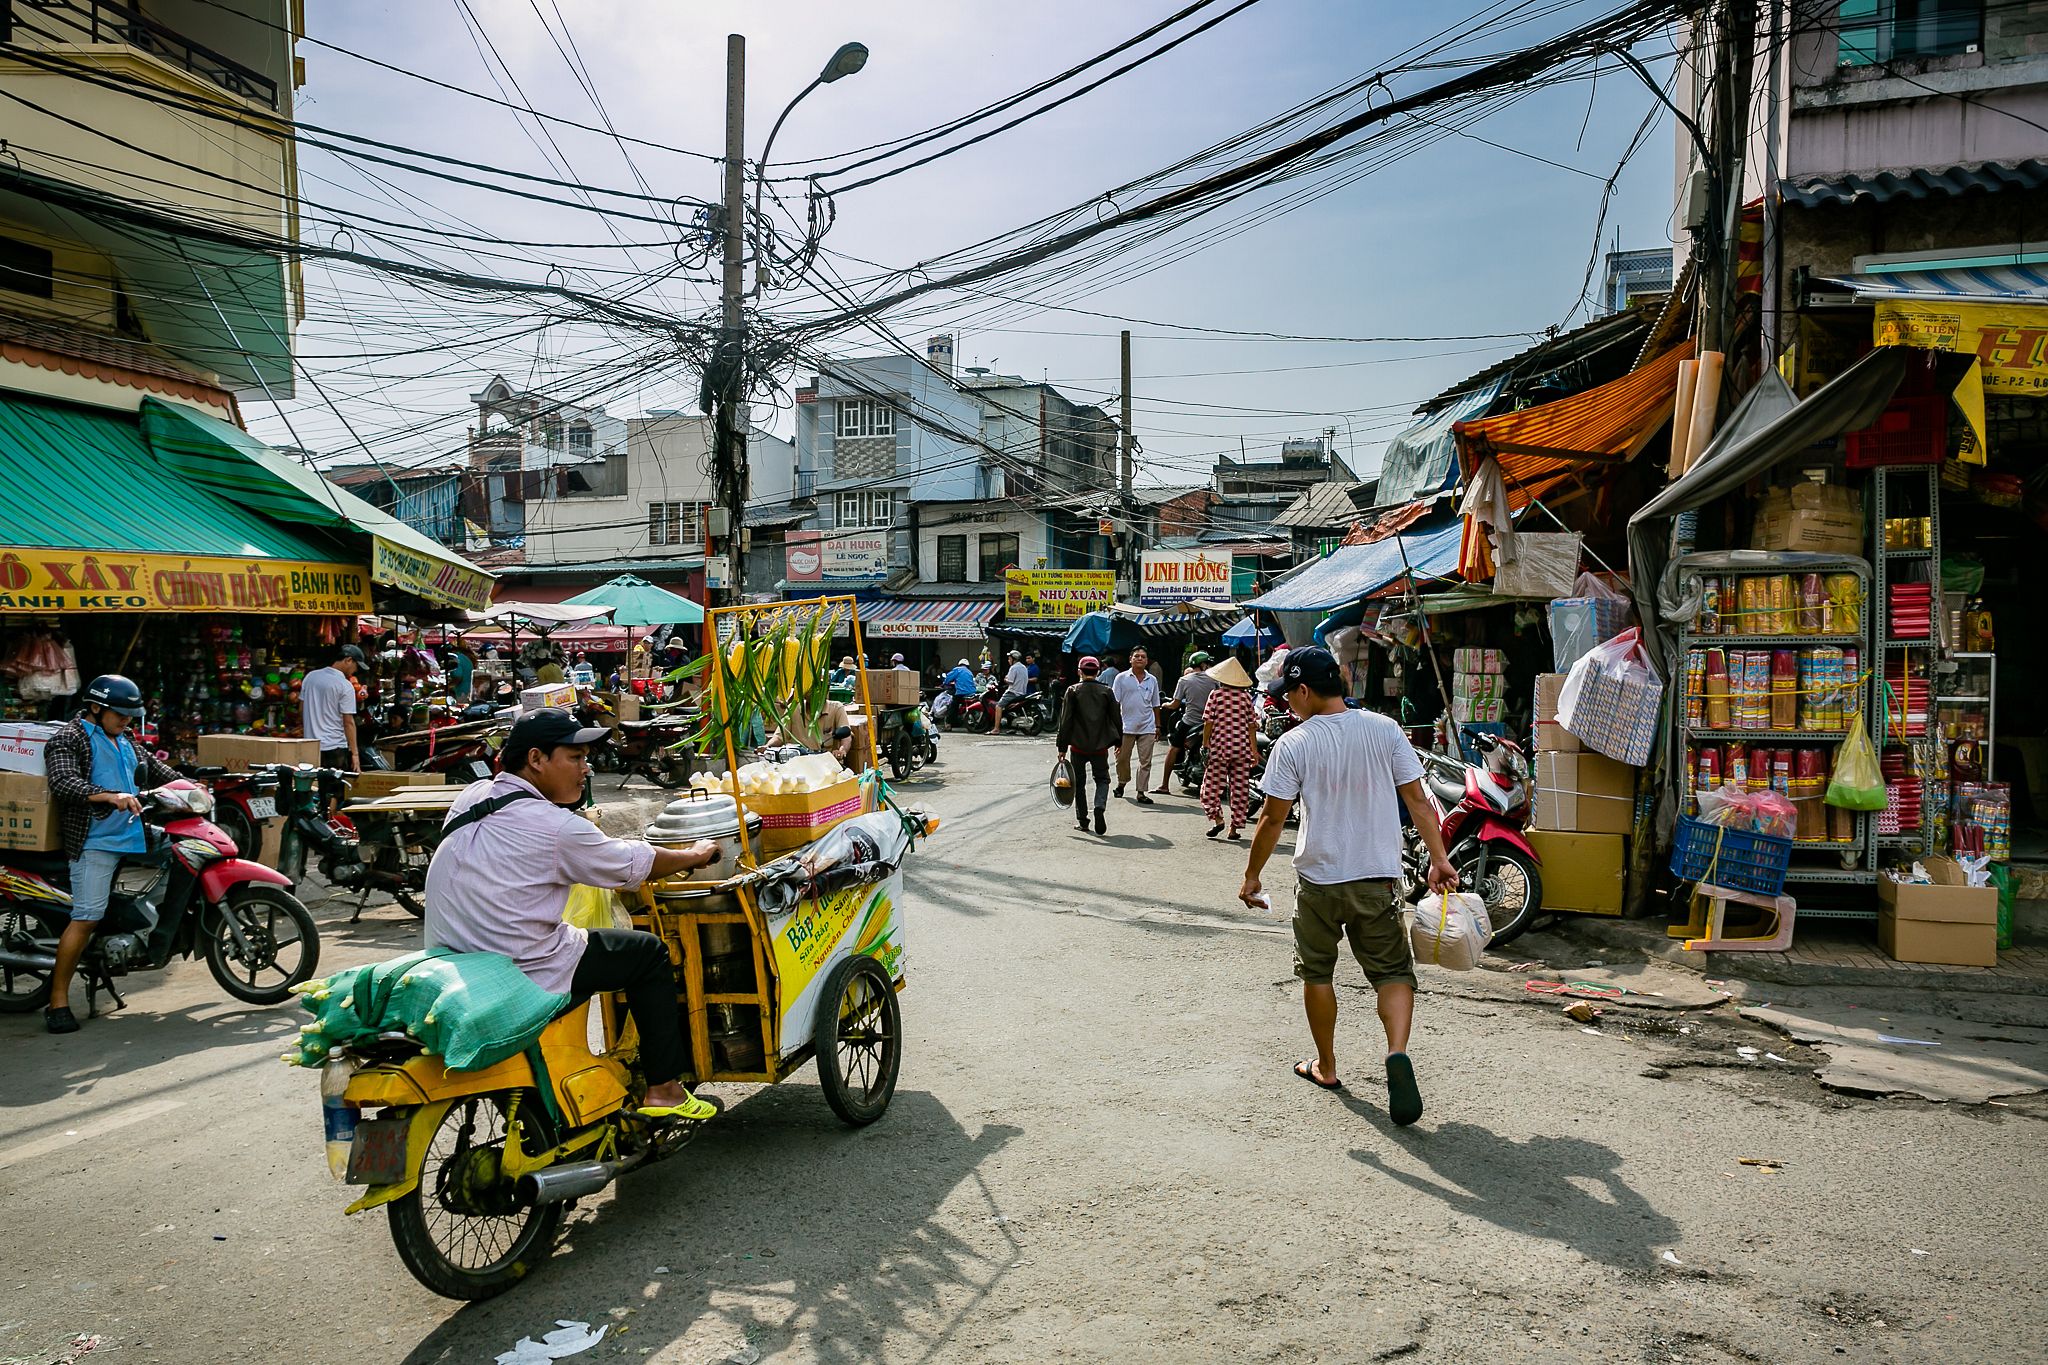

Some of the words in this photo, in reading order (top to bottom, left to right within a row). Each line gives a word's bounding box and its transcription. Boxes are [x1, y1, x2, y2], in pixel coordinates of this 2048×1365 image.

[2009, 376, 2025, 387] P.2
[847, 552, 870, 562] NGỌC
[40, 555, 140, 592] XÂY
[1144, 562, 1180, 583] LINH
[1183, 553, 1230, 583] HỒNG
[291, 565, 330, 595] BÁNH
[333, 573, 362, 600] KẸO
[1170, 585, 1181, 593] Bán
[1182, 585, 1192, 593] Gia
[1200, 585, 1211, 593] Các
[0, 592, 65, 608] ÁNH
[80, 595, 147, 610] KẸO
[1040, 587, 1068, 600] NHƯ
[1070, 587, 1108, 601] XUÂN
[308, 597, 318, 610] SỐ
[320, 600, 326, 610] 4
[882, 622, 912, 633] QUỐC
[915, 623, 939, 634] TỊNH
[813, 930, 842, 970] Nguyên
